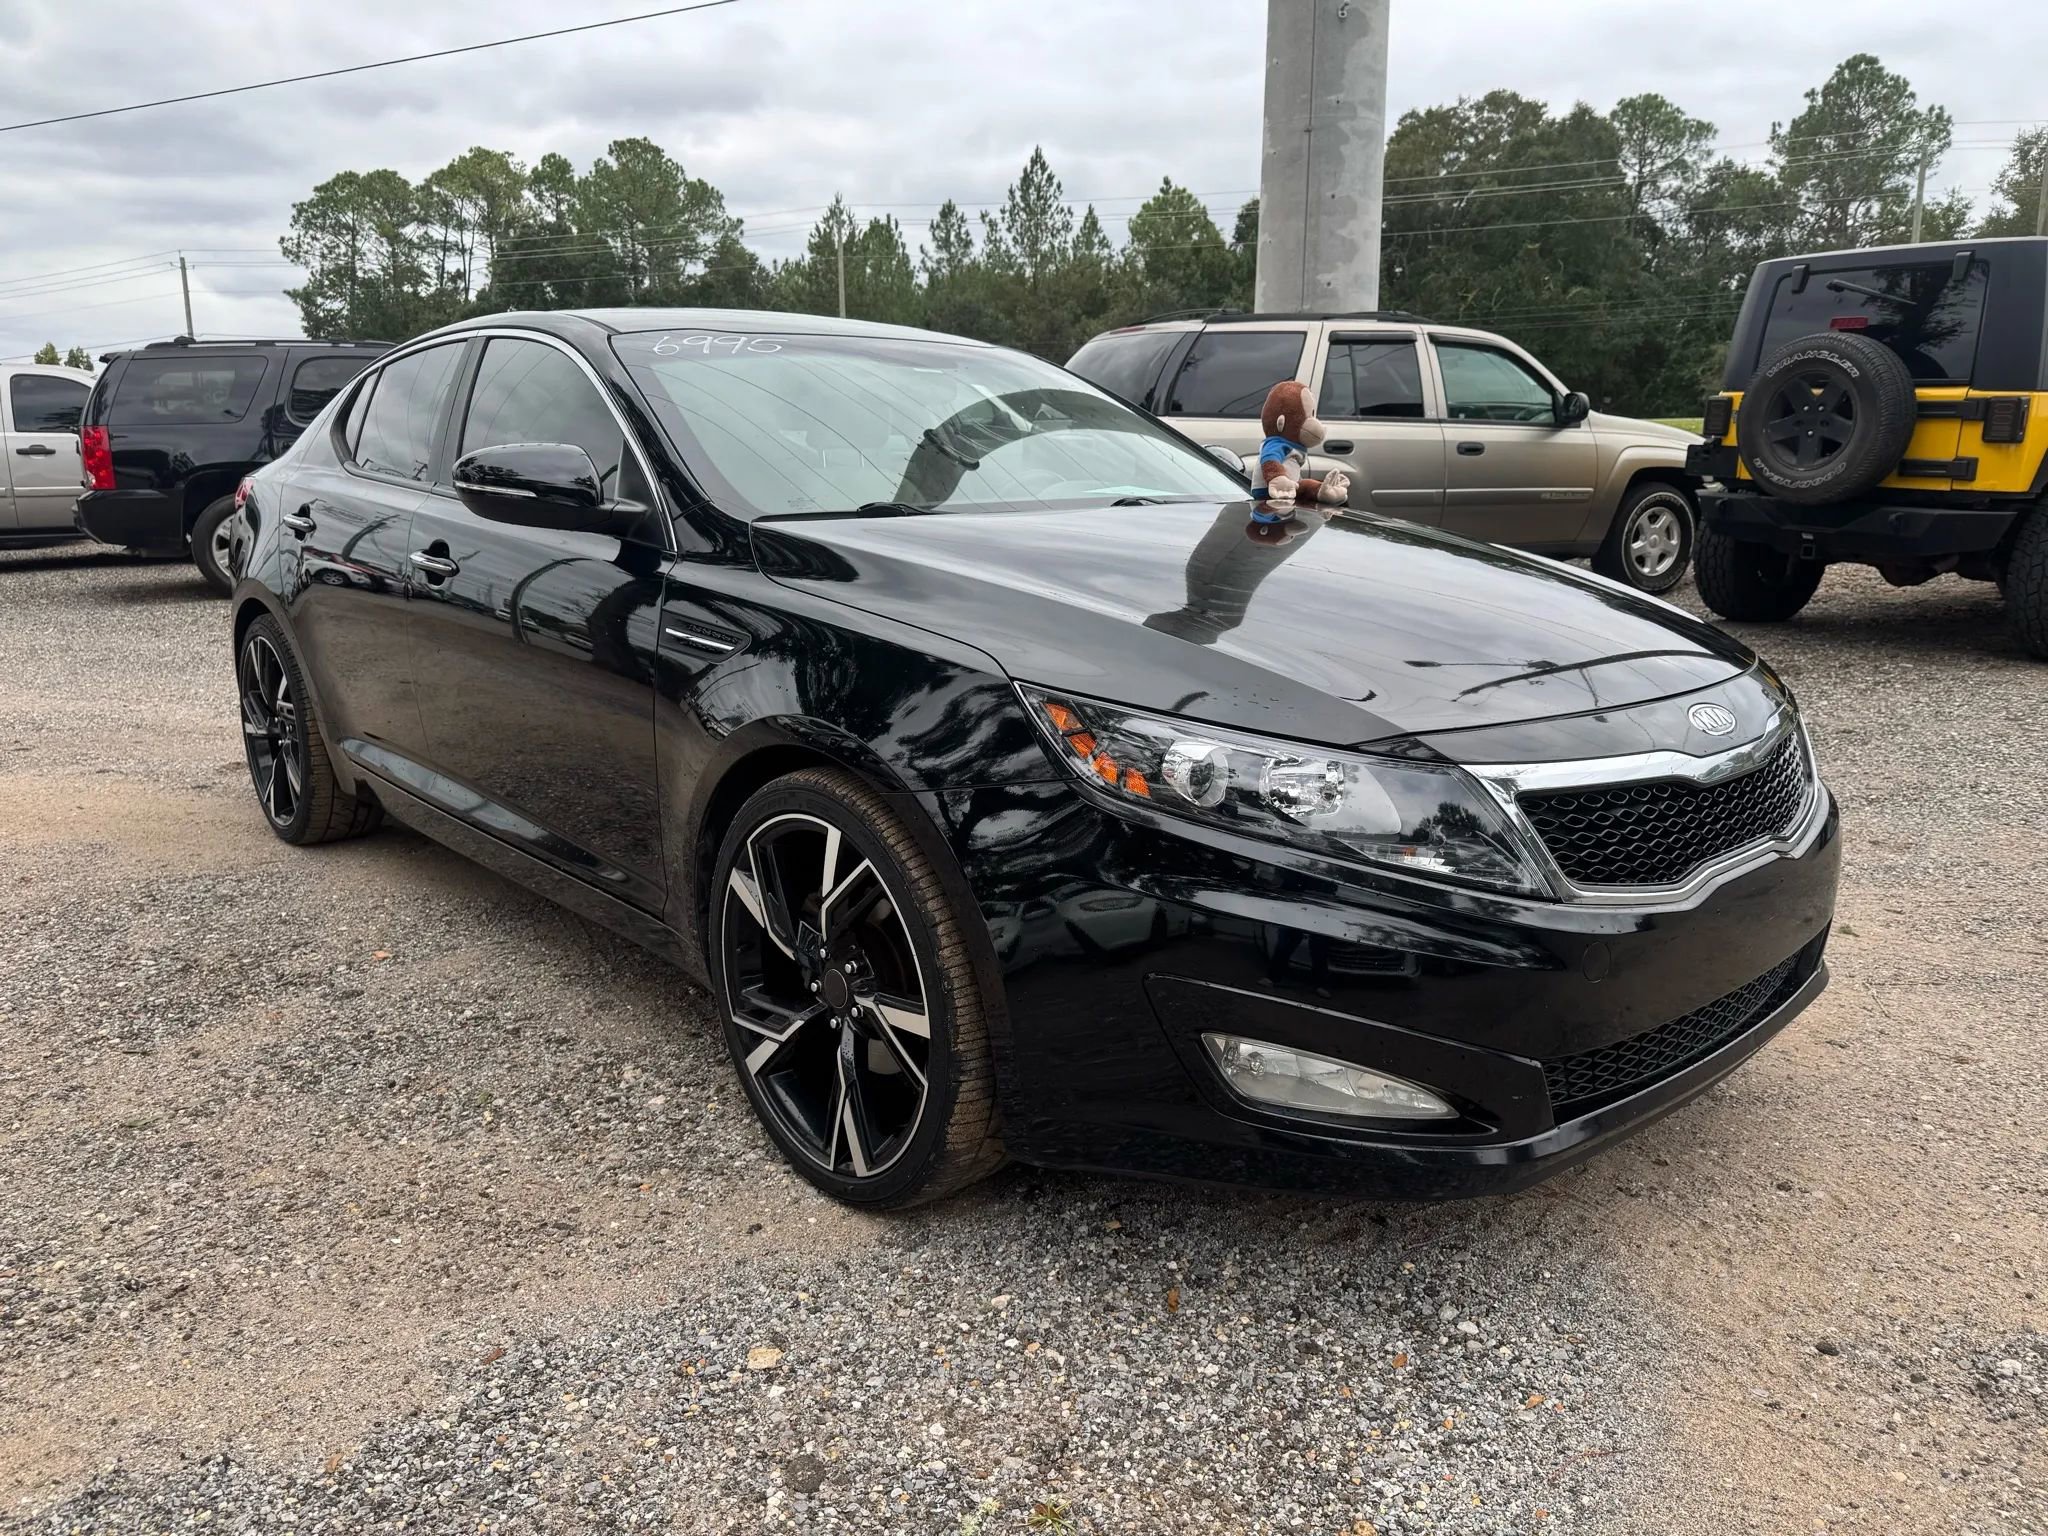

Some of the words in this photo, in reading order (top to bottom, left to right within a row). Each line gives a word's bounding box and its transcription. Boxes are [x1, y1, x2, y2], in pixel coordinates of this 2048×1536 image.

[653, 335, 789, 356] 6995
[1766, 350, 1861, 378] WRANGLER
[1753, 458, 1847, 488] GOODYEAR
[1691, 705, 1734, 732] KIA
